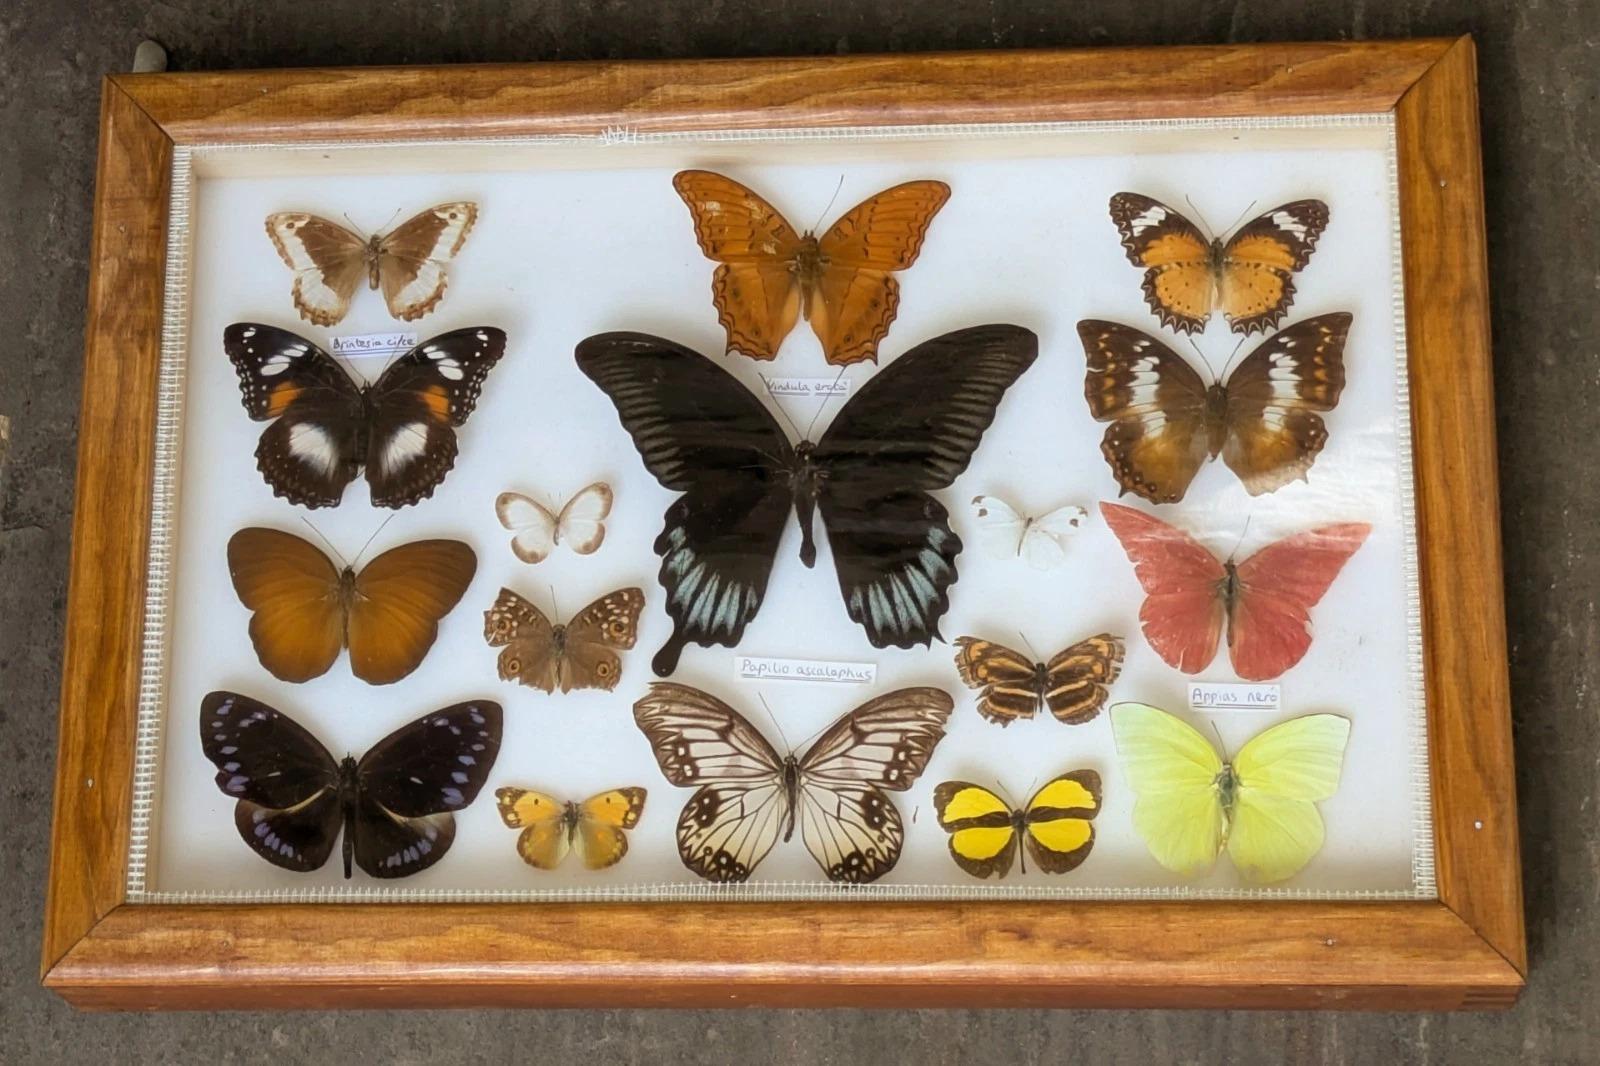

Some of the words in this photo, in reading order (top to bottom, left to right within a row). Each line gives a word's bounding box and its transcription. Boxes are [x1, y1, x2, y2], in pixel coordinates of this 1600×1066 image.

[741, 659, 790, 676] Papilio
[796, 665, 873, 681] ascalaphus
[1192, 688, 1238, 704] Appias
[1247, 692, 1278, 702] nero
